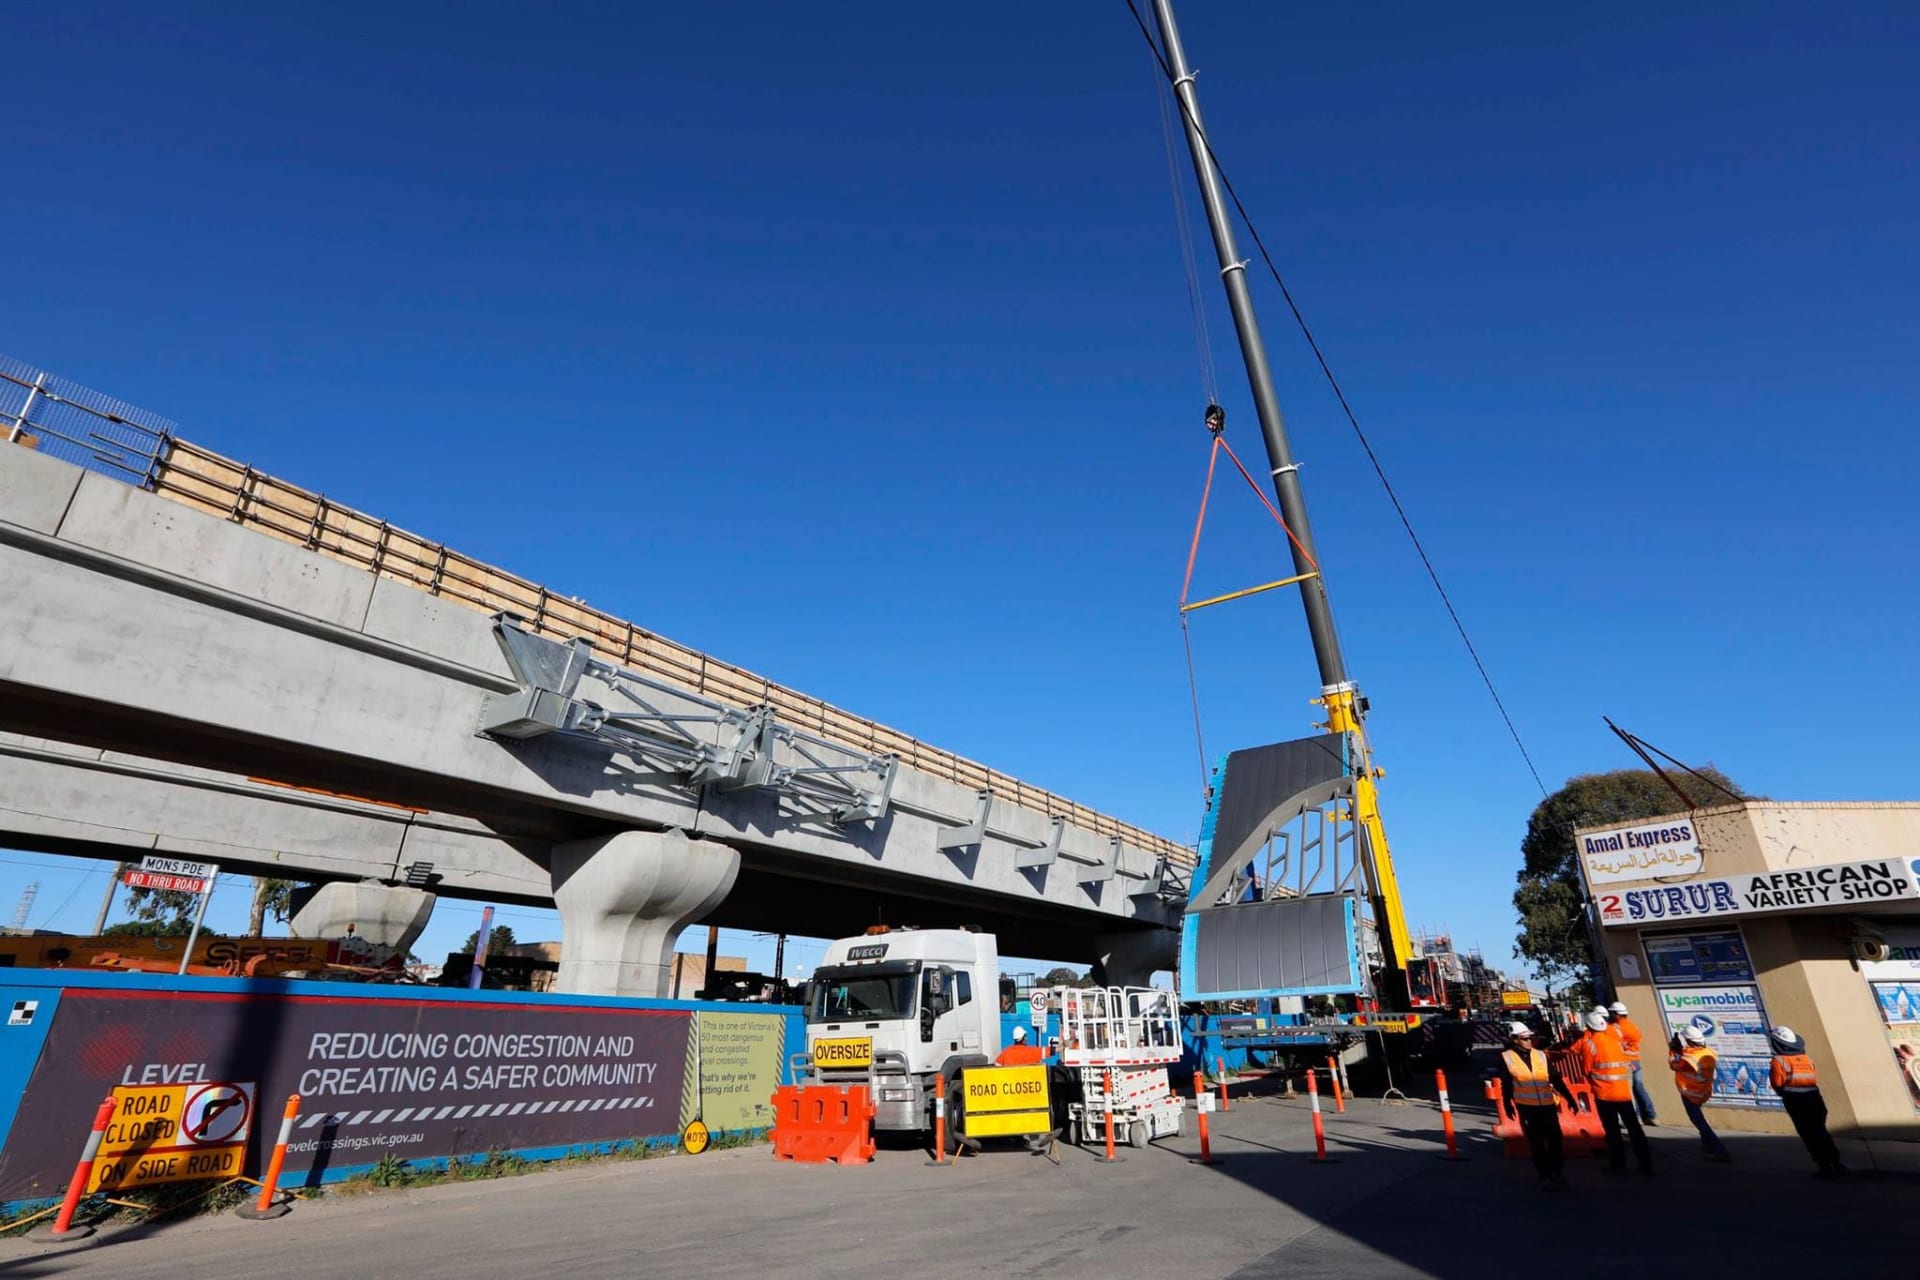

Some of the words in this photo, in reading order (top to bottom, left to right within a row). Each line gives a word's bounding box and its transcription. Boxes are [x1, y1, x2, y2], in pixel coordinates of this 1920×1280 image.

[1585, 834, 1624, 854] Amal
[1626, 826, 1692, 848] Express
[145, 858, 179, 872] MONS
[181, 863, 205, 875] PDE
[1750, 862, 1892, 892] AFRICAN
[129, 873, 144, 884] NO
[146, 875, 171, 888] THRU
[173, 879, 201, 892] ROAD
[1744, 886, 1830, 908] VARIETY
[1841, 878, 1908, 901] SHOP
[1600, 895, 1622, 912] 2
[1626, 881, 1739, 920] SURUR
[850, 947, 884, 958] IVECO
[1033, 996, 1046, 1006] 40
[1664, 992, 1756, 1008] Lycamobile
[703, 1021, 717, 1031] This
[308, 1033, 449, 1060] REDUCING
[453, 1034, 592, 1058] CONGESTION
[593, 1035, 634, 1058] AND
[815, 1043, 870, 1060] OVERSIZE
[121, 1063, 211, 1085] LEVEL
[299, 1066, 438, 1097] CREATING
[439, 1066, 458, 1092] A
[463, 1065, 538, 1090] SAFER
[543, 1063, 658, 1087] COMMUNITY
[970, 1083, 998, 1096] ROAD
[1002, 1081, 1042, 1095] CLOSED
[122, 1094, 171, 1117] ROAD
[105, 1119, 175, 1144] CLOSED
[286, 1132, 424, 1154] evelcrossings.vic.gov.au
[100, 1162, 127, 1184] ON
[136, 1158, 179, 1180] SIDE
[187, 1152, 233, 1174] ROAD
